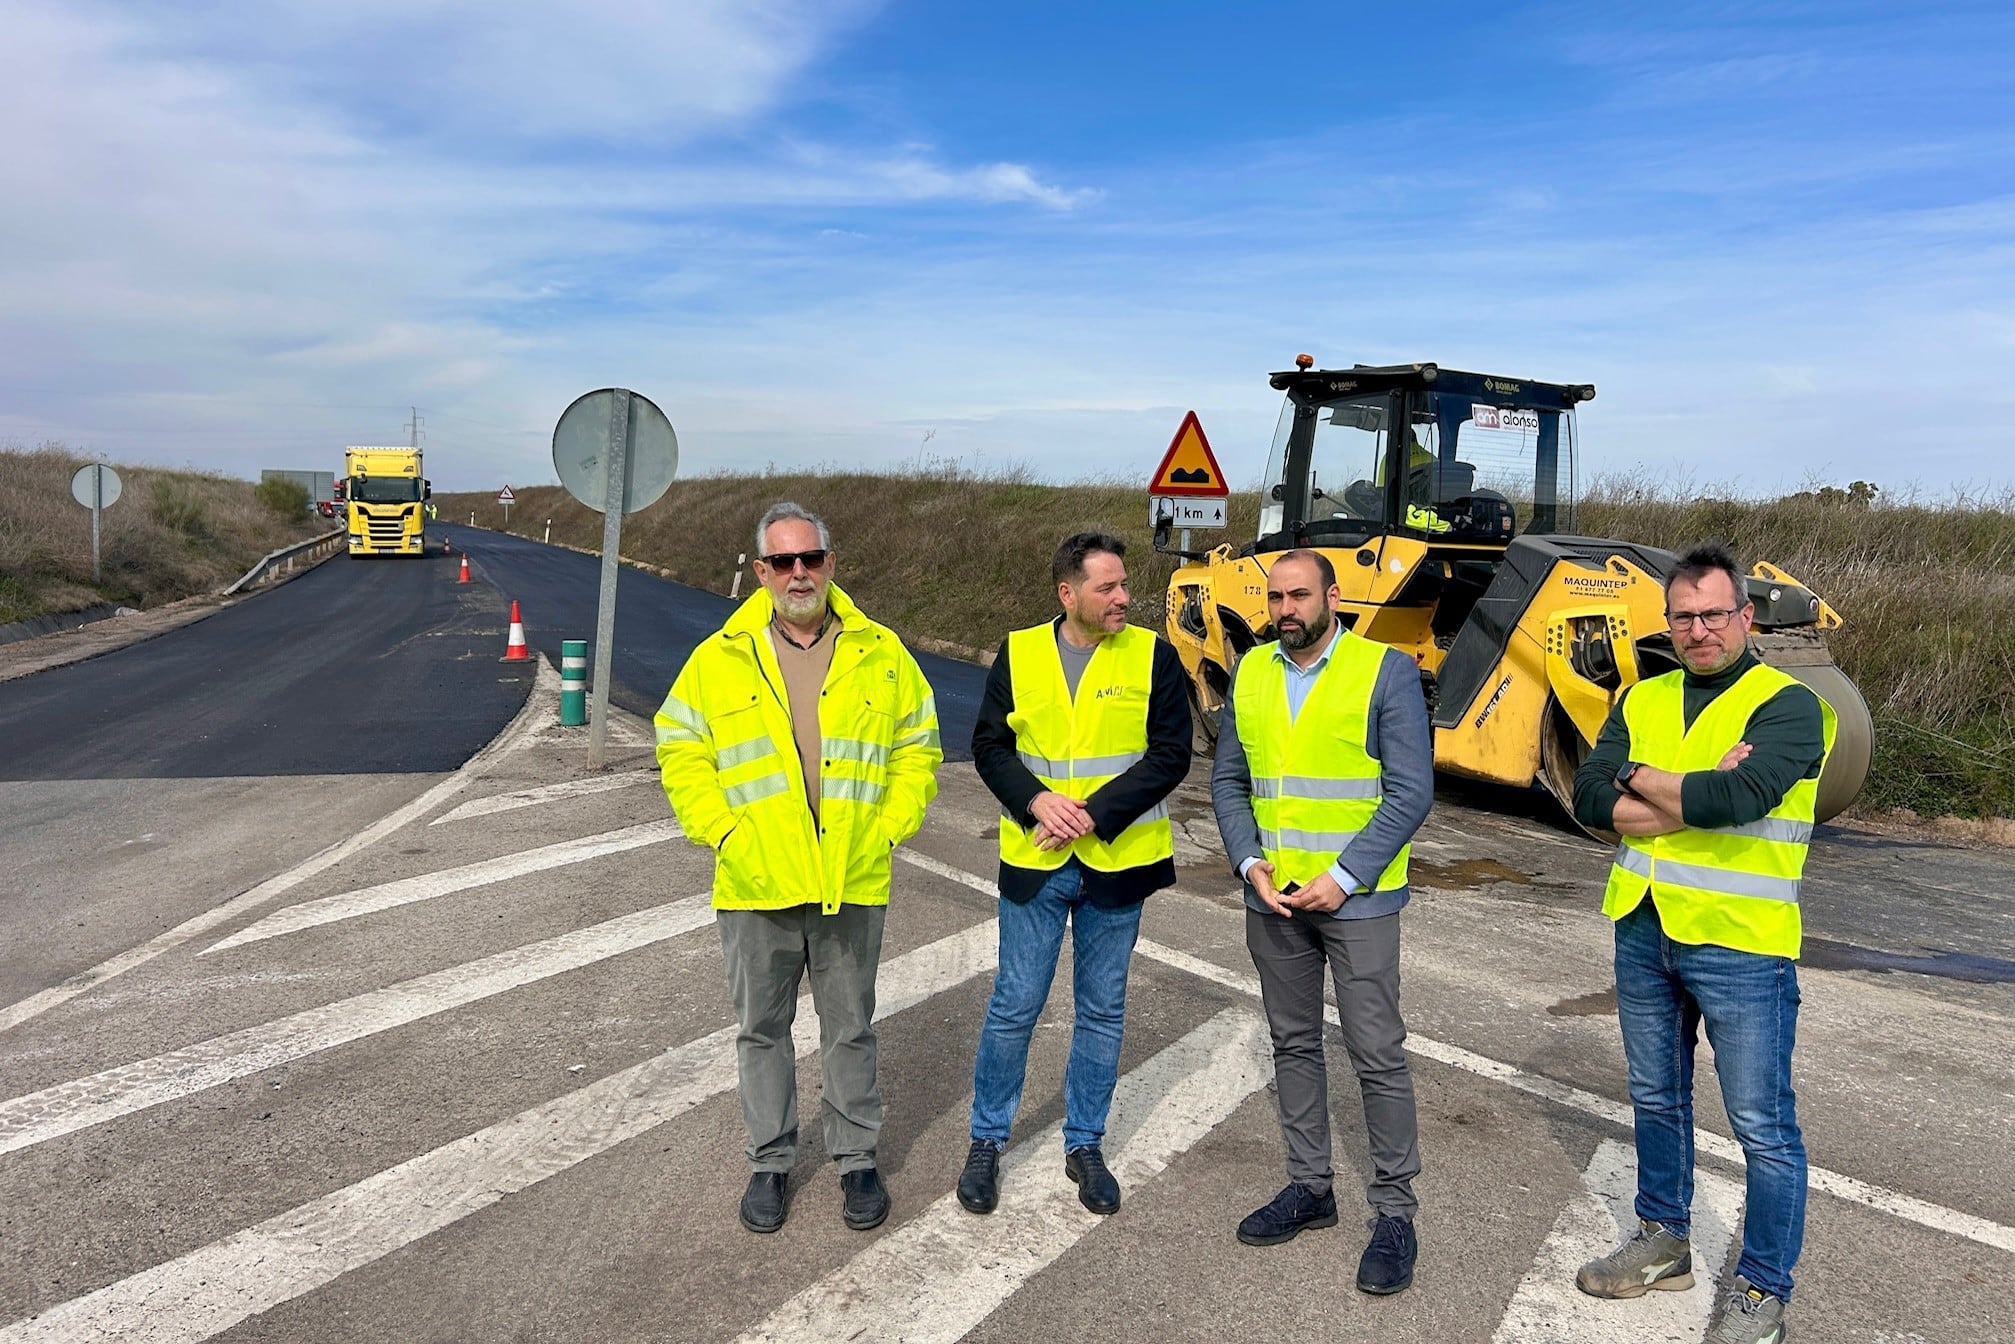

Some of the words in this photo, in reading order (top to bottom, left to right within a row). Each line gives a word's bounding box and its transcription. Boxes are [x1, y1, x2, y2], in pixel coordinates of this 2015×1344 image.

[1495, 381, 1520, 392] BOMAG
[1503, 410, 1538, 428] alonso
[1175, 506, 1180, 518] 1
[1184, 506, 1203, 519] km
